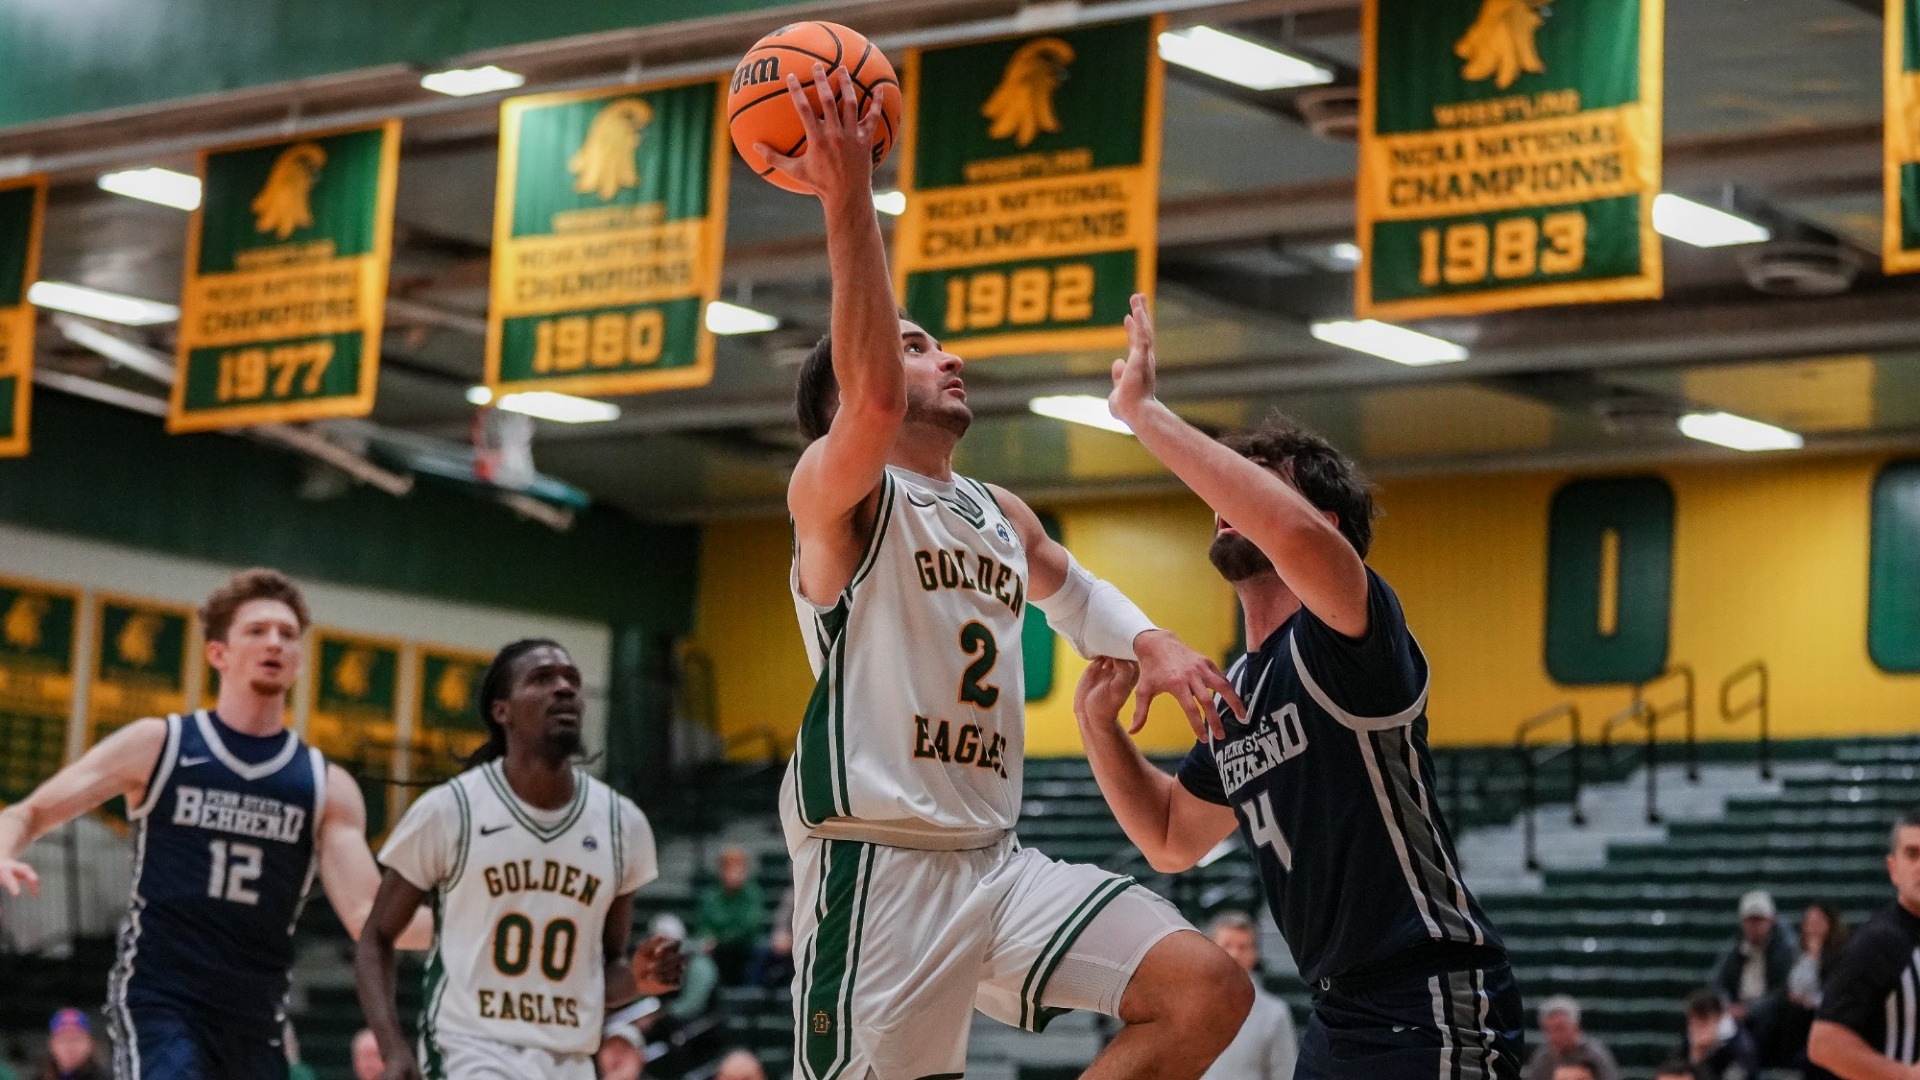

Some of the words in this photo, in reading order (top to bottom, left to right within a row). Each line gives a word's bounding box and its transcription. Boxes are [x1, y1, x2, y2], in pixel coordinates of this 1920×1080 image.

[731, 55, 780, 94] Wil
[1389, 152, 1623, 208] CHAMPIONS
[1418, 210, 1588, 288] 1983
[944, 263, 1095, 332] 1982
[217, 340, 336, 402] 1977
[533, 308, 665, 374] 1980
[914, 547, 1024, 619] GOLDEN
[958, 618, 1000, 711] 2
[172, 784, 306, 845] BEHREND
[1240, 789, 1293, 875] 4
[207, 838, 264, 906] 12
[484, 858, 603, 908] GOLDEN
[491, 909, 579, 983] 00
[478, 989, 581, 1029] EAGLES
